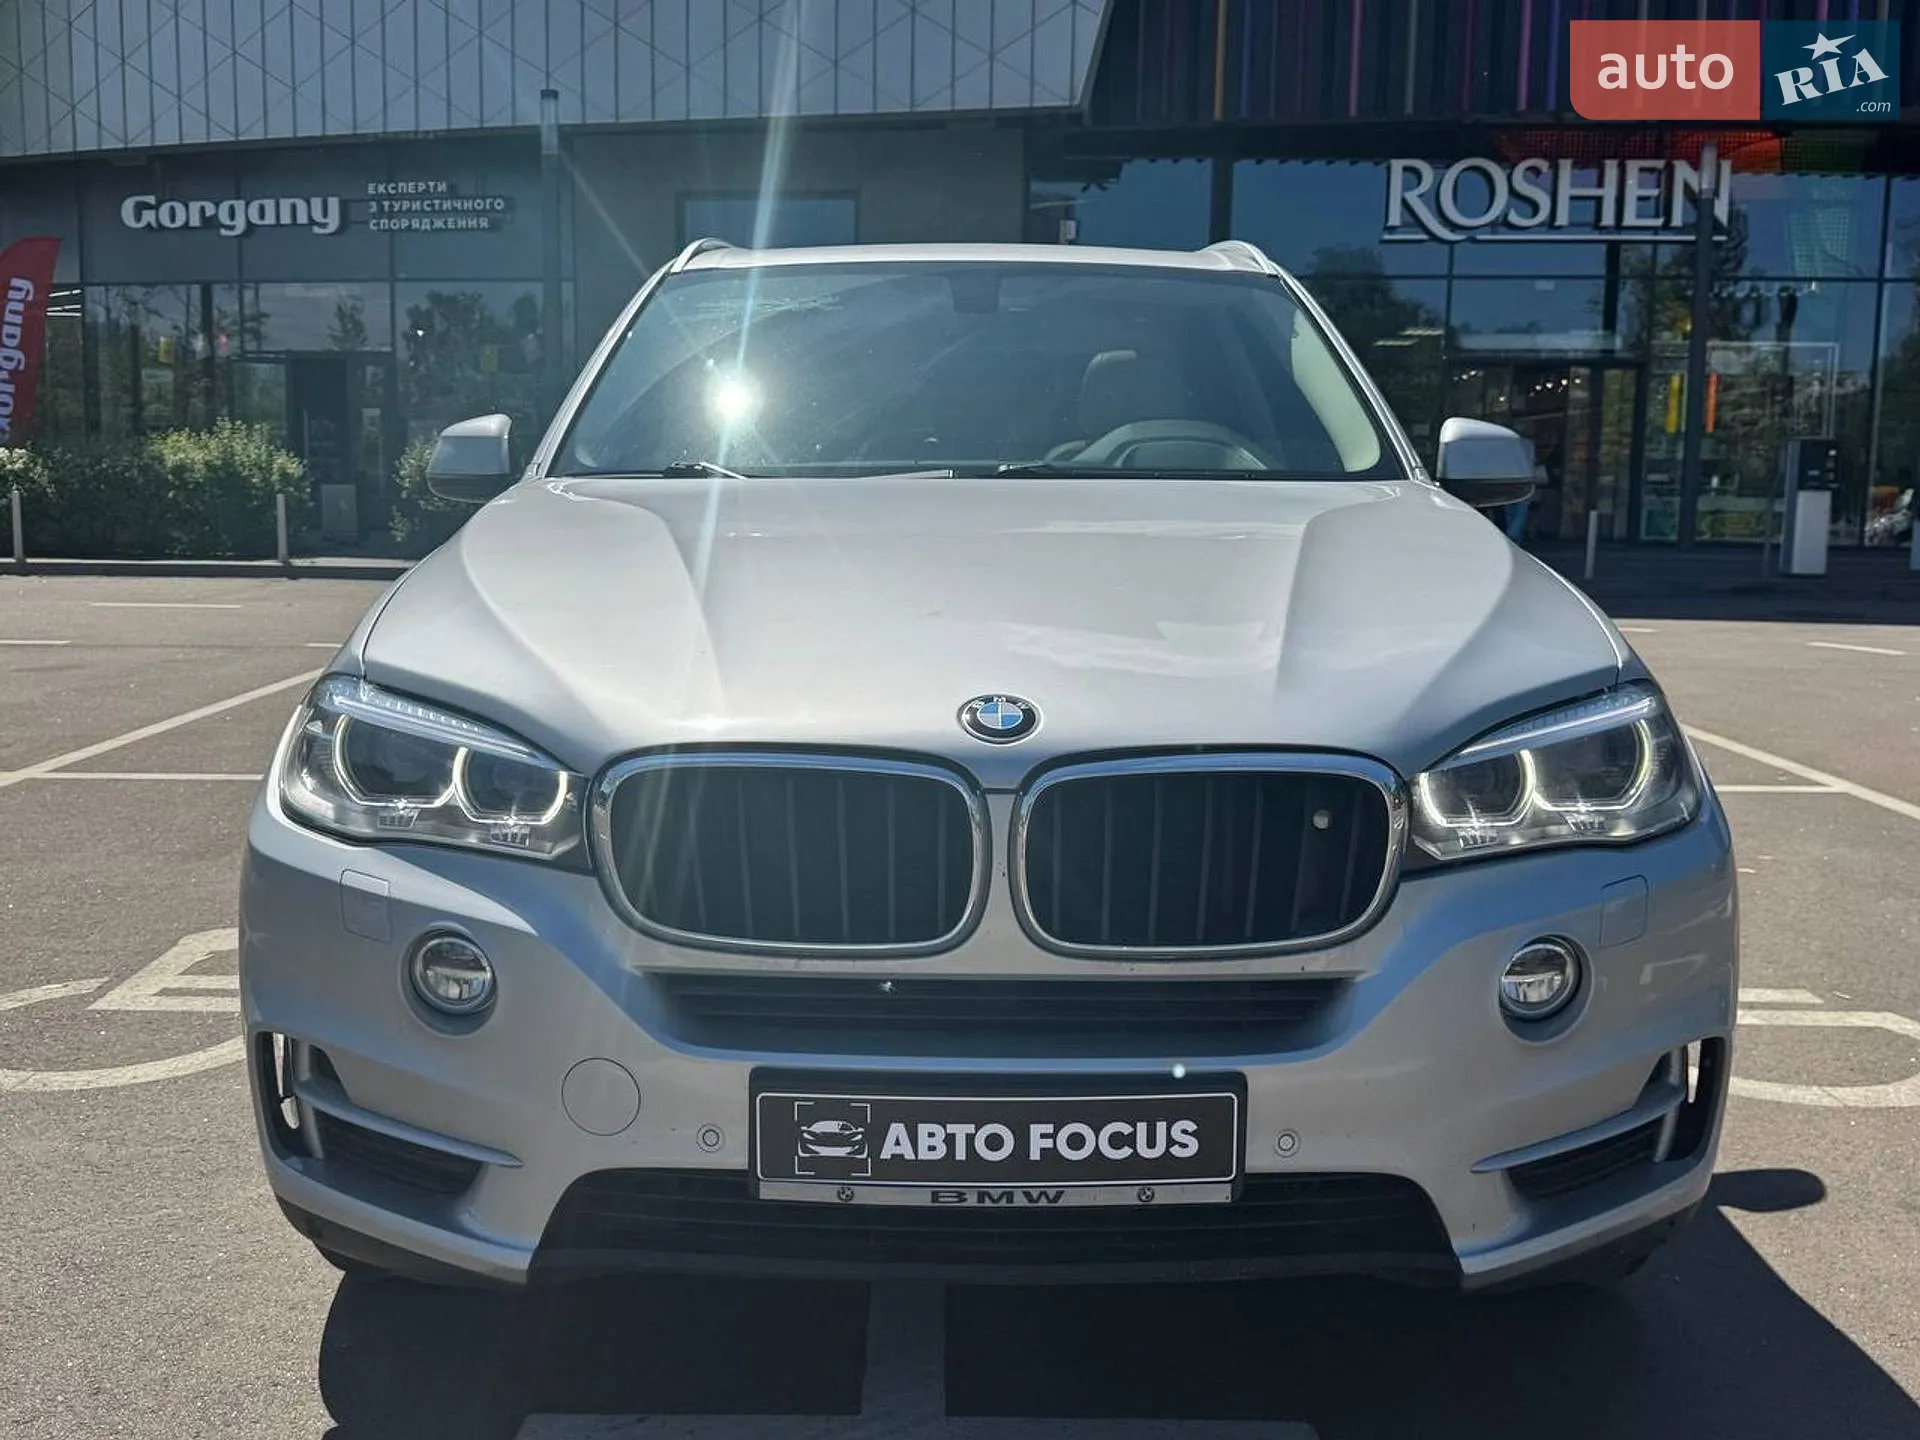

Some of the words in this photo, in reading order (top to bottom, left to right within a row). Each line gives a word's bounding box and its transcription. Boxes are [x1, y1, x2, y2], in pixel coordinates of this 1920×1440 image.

[367, 181, 447, 195] ЕКСПЕРТИ
[382, 198, 505, 212] ТУРИСТИЧНОГО
[1382, 157, 1732, 242] ROSHEN
[121, 194, 341, 236] Gorgany
[369, 217, 490, 231] СПОРЯДЖЕННЯ
[1029, 1120, 1199, 1161] FOCUS
[930, 1189, 1065, 1205] BMW
